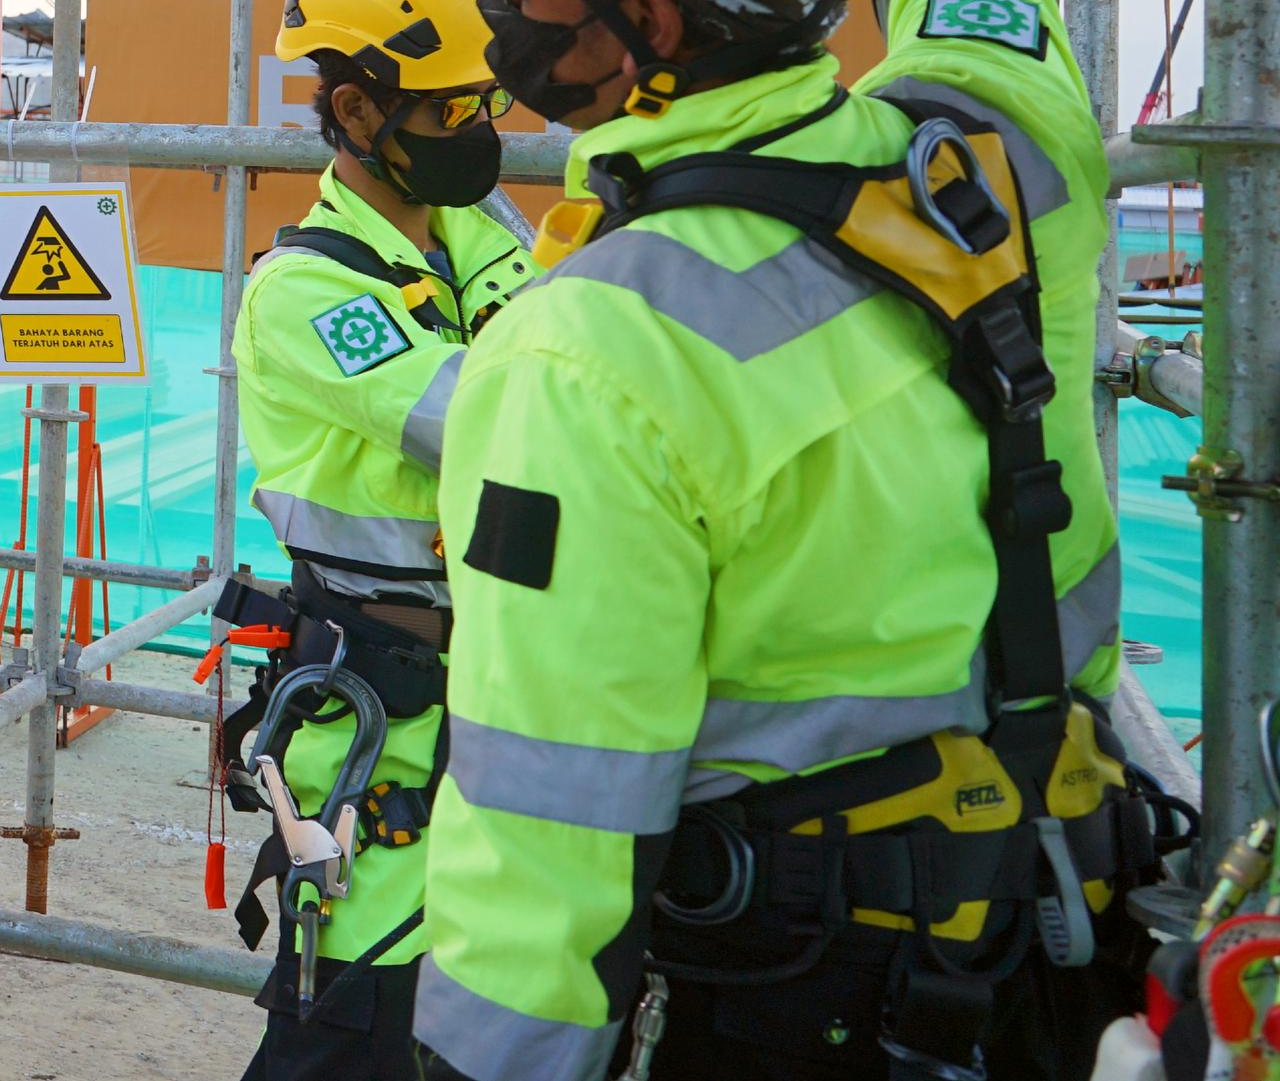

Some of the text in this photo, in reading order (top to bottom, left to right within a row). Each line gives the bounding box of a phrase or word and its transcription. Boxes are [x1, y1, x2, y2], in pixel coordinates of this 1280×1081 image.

[19, 328, 104, 337] BAHAYA BARANG
[13, 339, 114, 348] TERJATUH DARI ATAS
[956, 785, 1005, 817] PETZL
